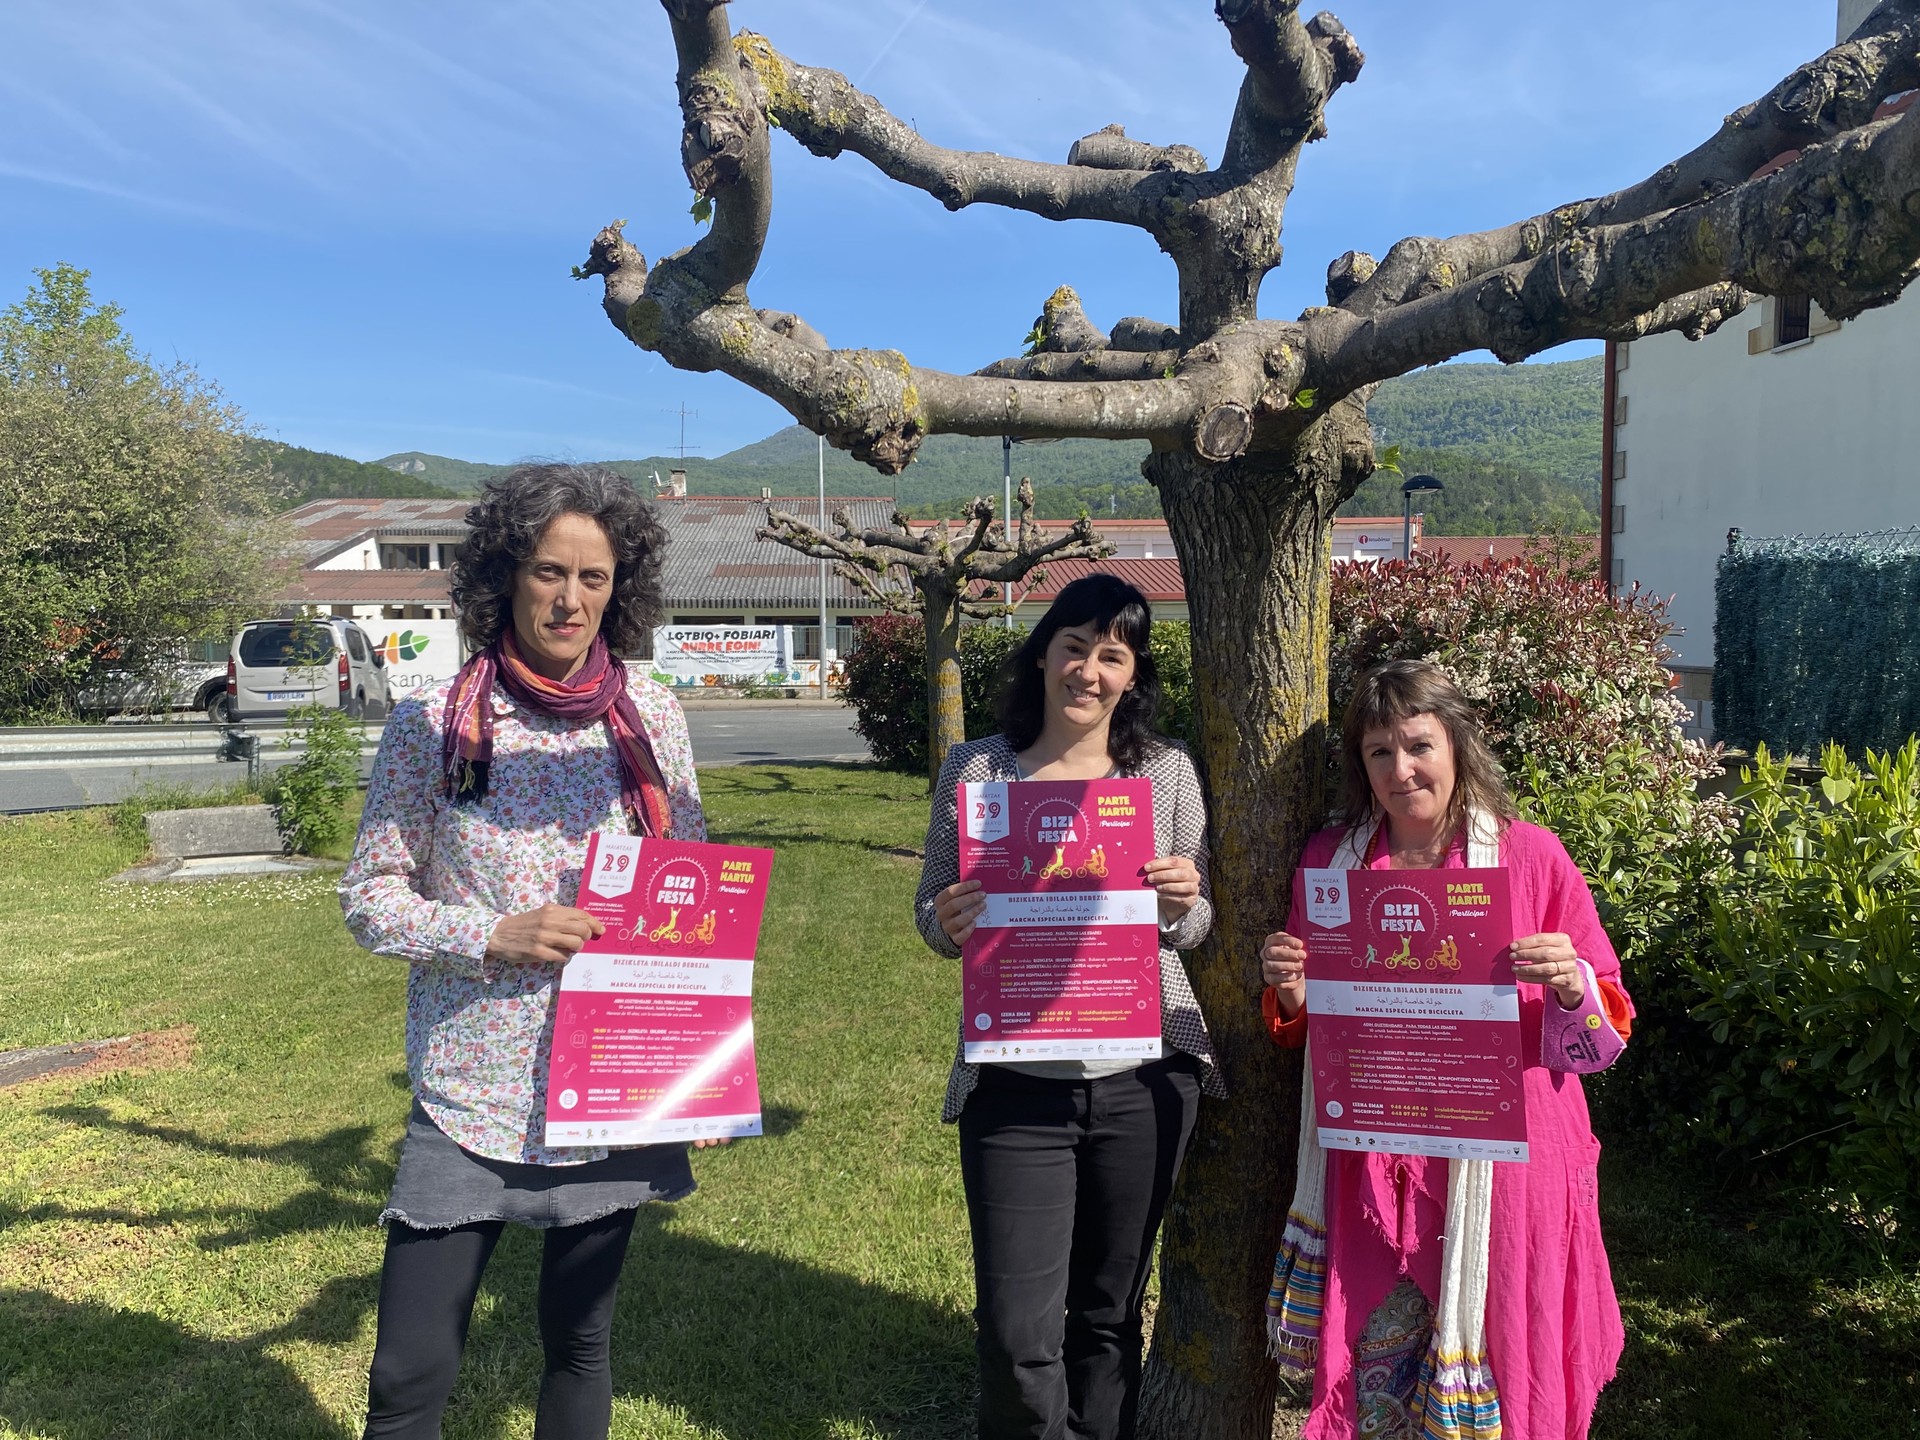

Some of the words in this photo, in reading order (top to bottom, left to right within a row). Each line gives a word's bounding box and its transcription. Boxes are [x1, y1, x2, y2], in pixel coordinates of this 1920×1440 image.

[668, 631, 720, 642] LGTBIQ+
[723, 630, 776, 640] FOBIARI
[681, 642, 722, 651] AURRE
[726, 641, 761, 651] EGIN!
[1098, 796, 1130, 805] PARTE
[975, 802, 1001, 819] 29
[1098, 807, 1136, 816] HARTU!
[1041, 816, 1073, 828] BIZI
[1037, 830, 1078, 843] FESTA
[601, 853, 629, 872] 29
[722, 860, 752, 871] PARTE
[664, 875, 696, 889] BIZI
[720, 872, 755, 884] HARTU!
[1446, 883, 1484, 893] PARTE
[656, 890, 695, 905] FESTA
[1314, 887, 1340, 904] 29
[1447, 895, 1491, 906] HARTU!
[1383, 904, 1419, 916] BIZI
[1380, 919, 1425, 932] FESTA
[681, 961, 710, 969] BEREZIA
[1353, 985, 1391, 993] BIZIKLETA
[1429, 987, 1463, 995] BEREZIA
